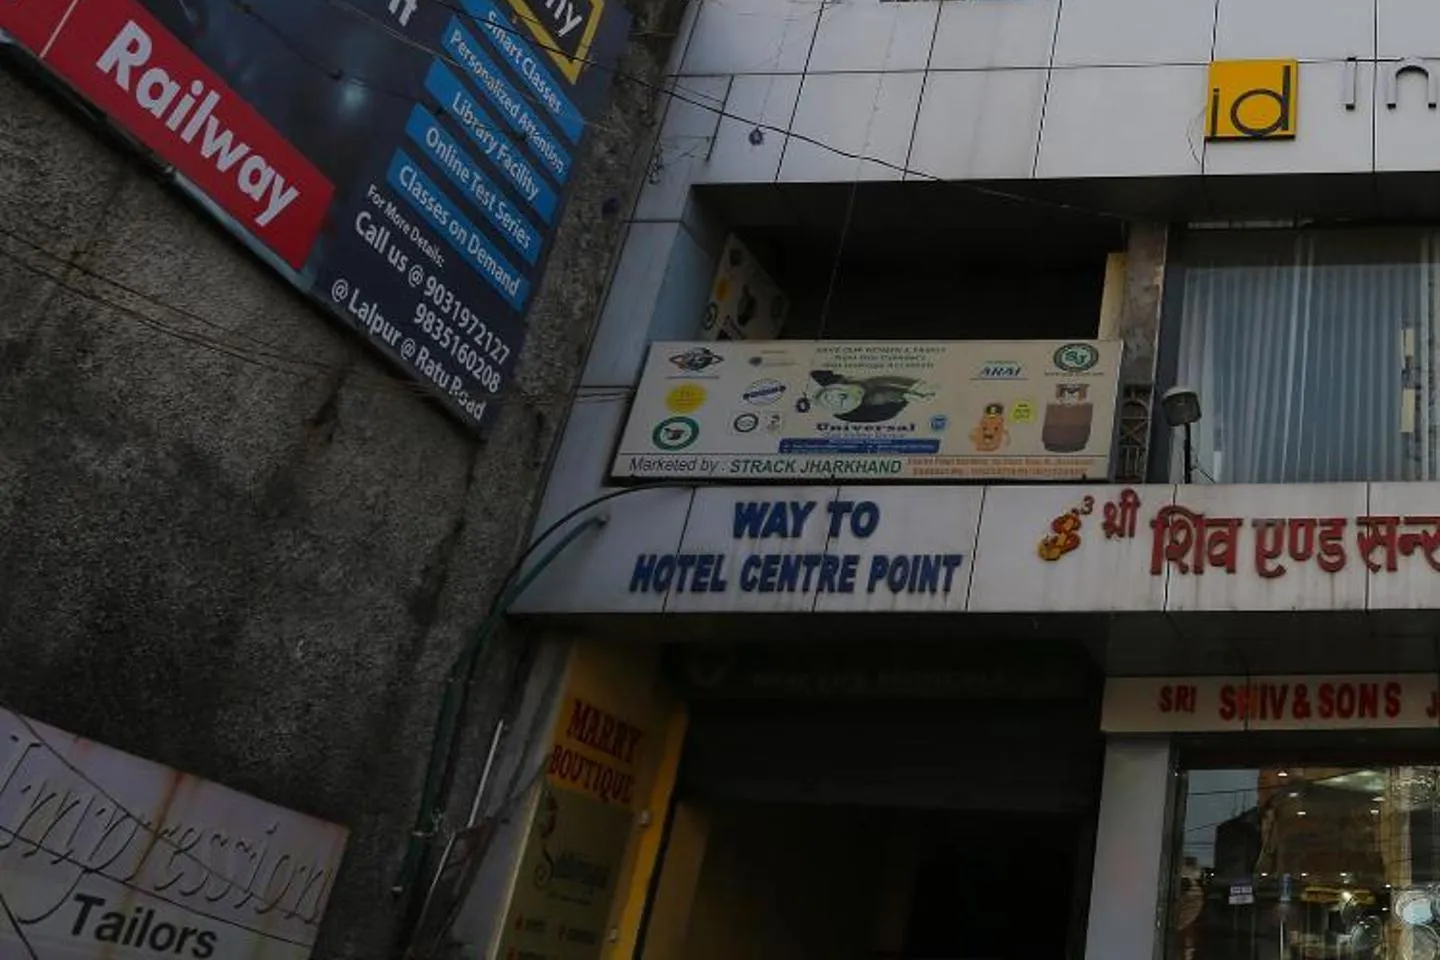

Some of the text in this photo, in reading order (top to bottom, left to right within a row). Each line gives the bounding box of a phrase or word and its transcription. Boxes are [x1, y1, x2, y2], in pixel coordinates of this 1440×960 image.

[451, 30, 565, 174] Personalized Attention
[485, 11, 563, 114] Smart Classes
[1206, 64, 1292, 139] id
[96, 20, 300, 227] Railway
[453, 92, 539, 201] Library Facility
[368, 184, 386, 209] For
[384, 205, 410, 235] More
[400, 166, 521, 297] Classes on Demand
[426, 128, 531, 250] Online Test Series
[356, 211, 510, 364] Call us @ 9031972127
[332, 279, 487, 421] @ Lalpur @ Ratu Road
[414, 303, 501, 393] 9835160208
[628, 457, 698, 471] Marketed
[700, 458, 718, 474] by
[730, 459, 796, 473] STRACK
[800, 459, 902, 474] JHARKHAND
[733, 501, 880, 538] WAY TO
[1103, 488, 1141, 538] श्री
[1150, 504, 1243, 576] शिव
[1253, 516, 1347, 579] एण्ड
[630, 554, 962, 593] HOTEL CENTRE POINT
[1158, 685, 1196, 713] SRI
[549, 743, 636, 804] BOUTIQUE
[71, 893, 219, 959] Tailors
